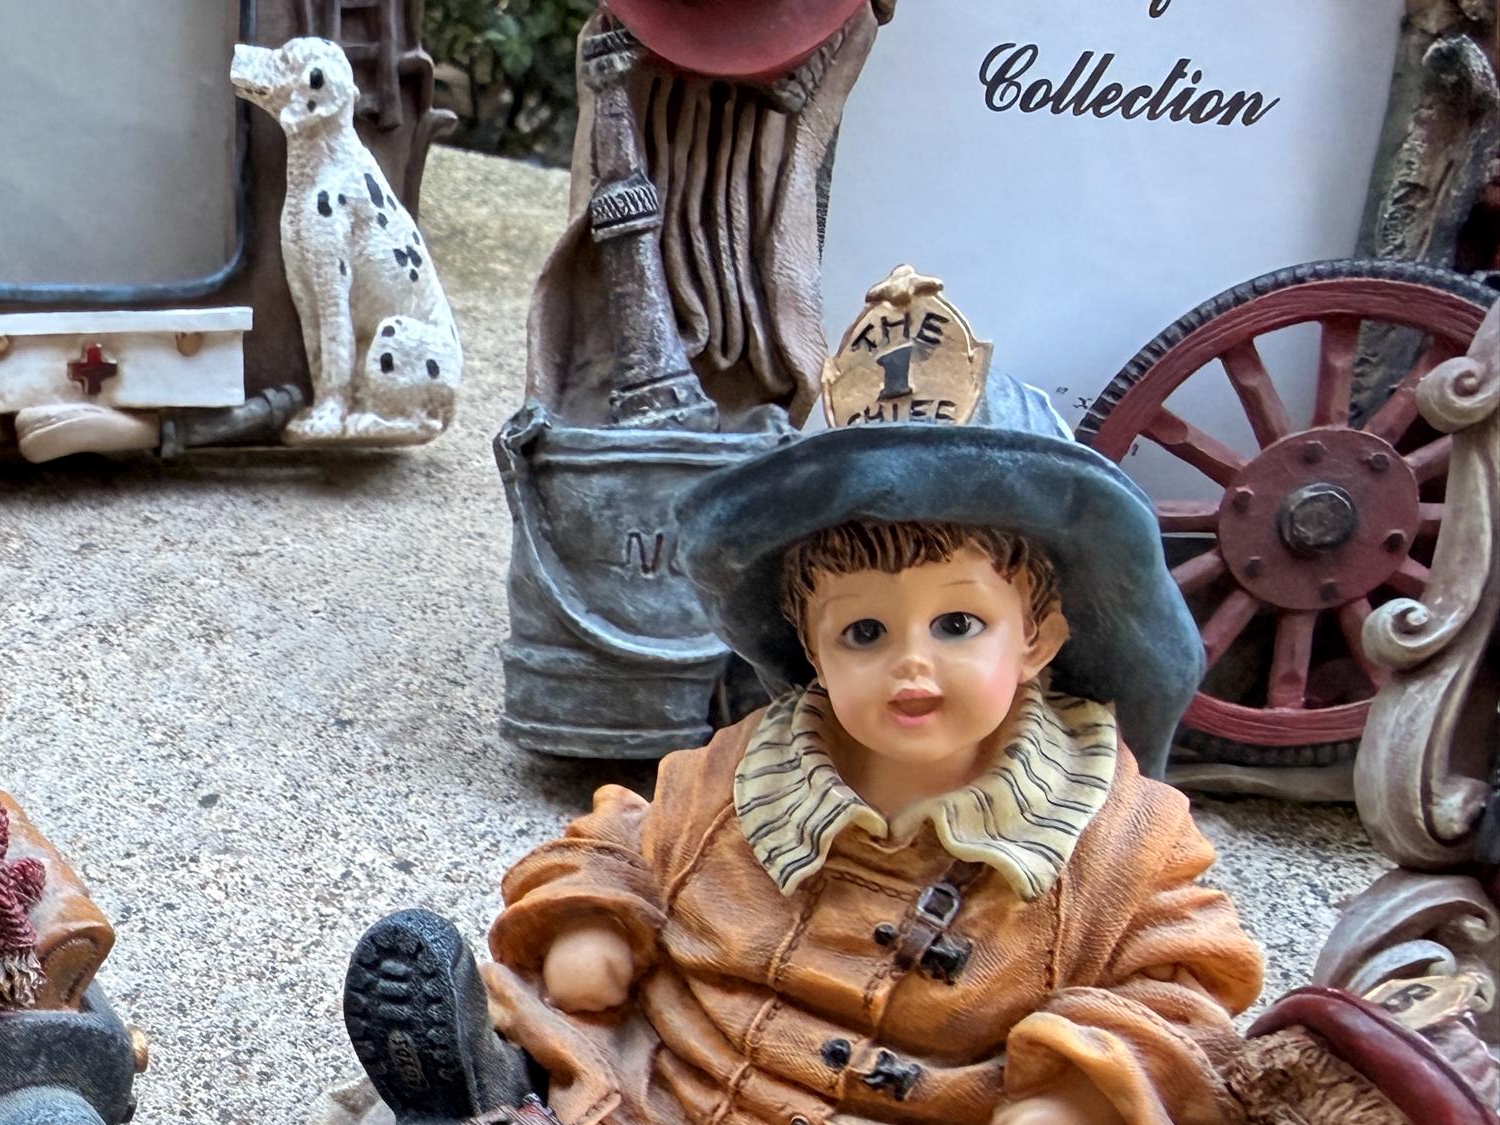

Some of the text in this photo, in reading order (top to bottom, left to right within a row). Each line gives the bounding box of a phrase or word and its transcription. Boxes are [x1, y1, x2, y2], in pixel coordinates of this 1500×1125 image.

[978, 42, 1281, 127] Collection
[851, 311, 950, 352] THE
[876, 345, 914, 401] 1
